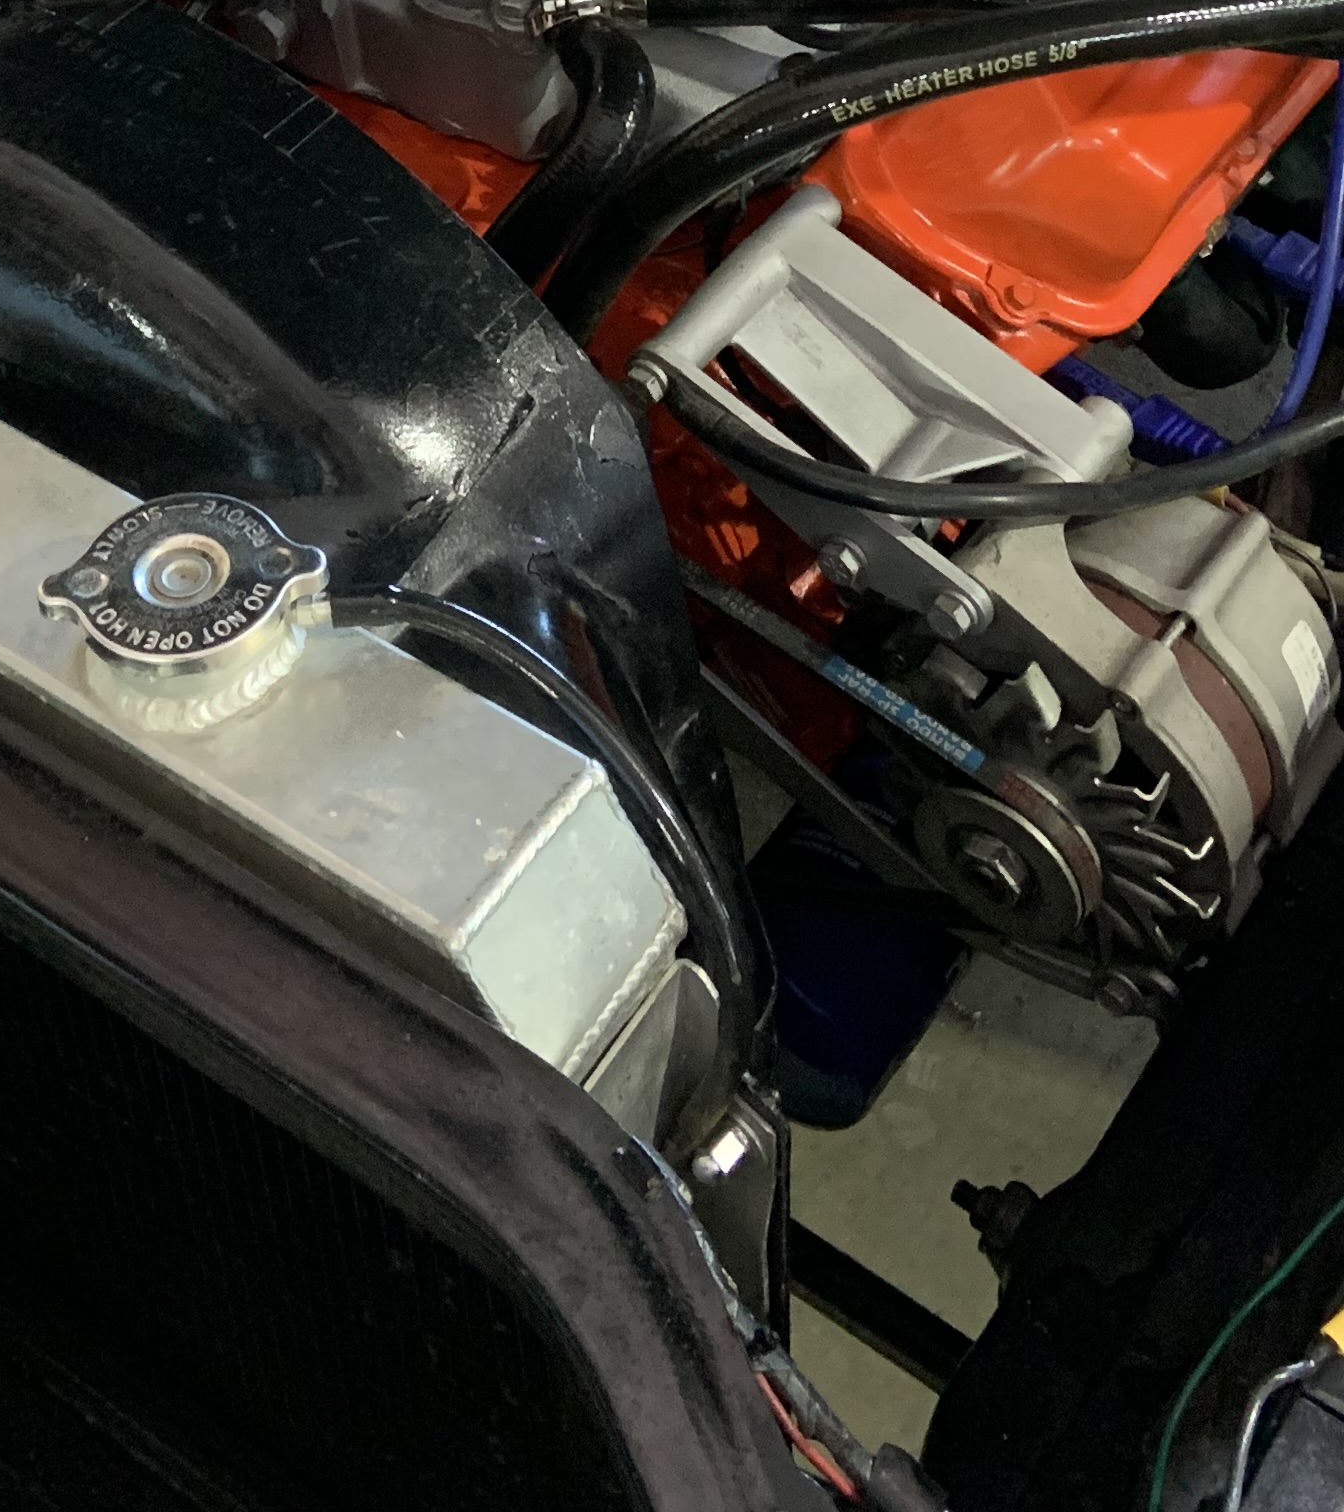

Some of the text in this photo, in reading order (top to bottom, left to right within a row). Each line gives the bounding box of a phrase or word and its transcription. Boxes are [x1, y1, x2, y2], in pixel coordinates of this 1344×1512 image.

[830, 95, 877, 123] EXE
[885, 66, 974, 104] HEATER
[977, 50, 1039, 79] HOSE
[91, 506, 163, 563] SLOWLY
[200, 499, 272, 549] REMOVE
[244, 583, 272, 612] DO
[88, 600, 128, 636] HOT
[202, 610, 247, 645] NOT
[125, 627, 193, 651] OPEN
[906, 718, 968, 761] BANDO
